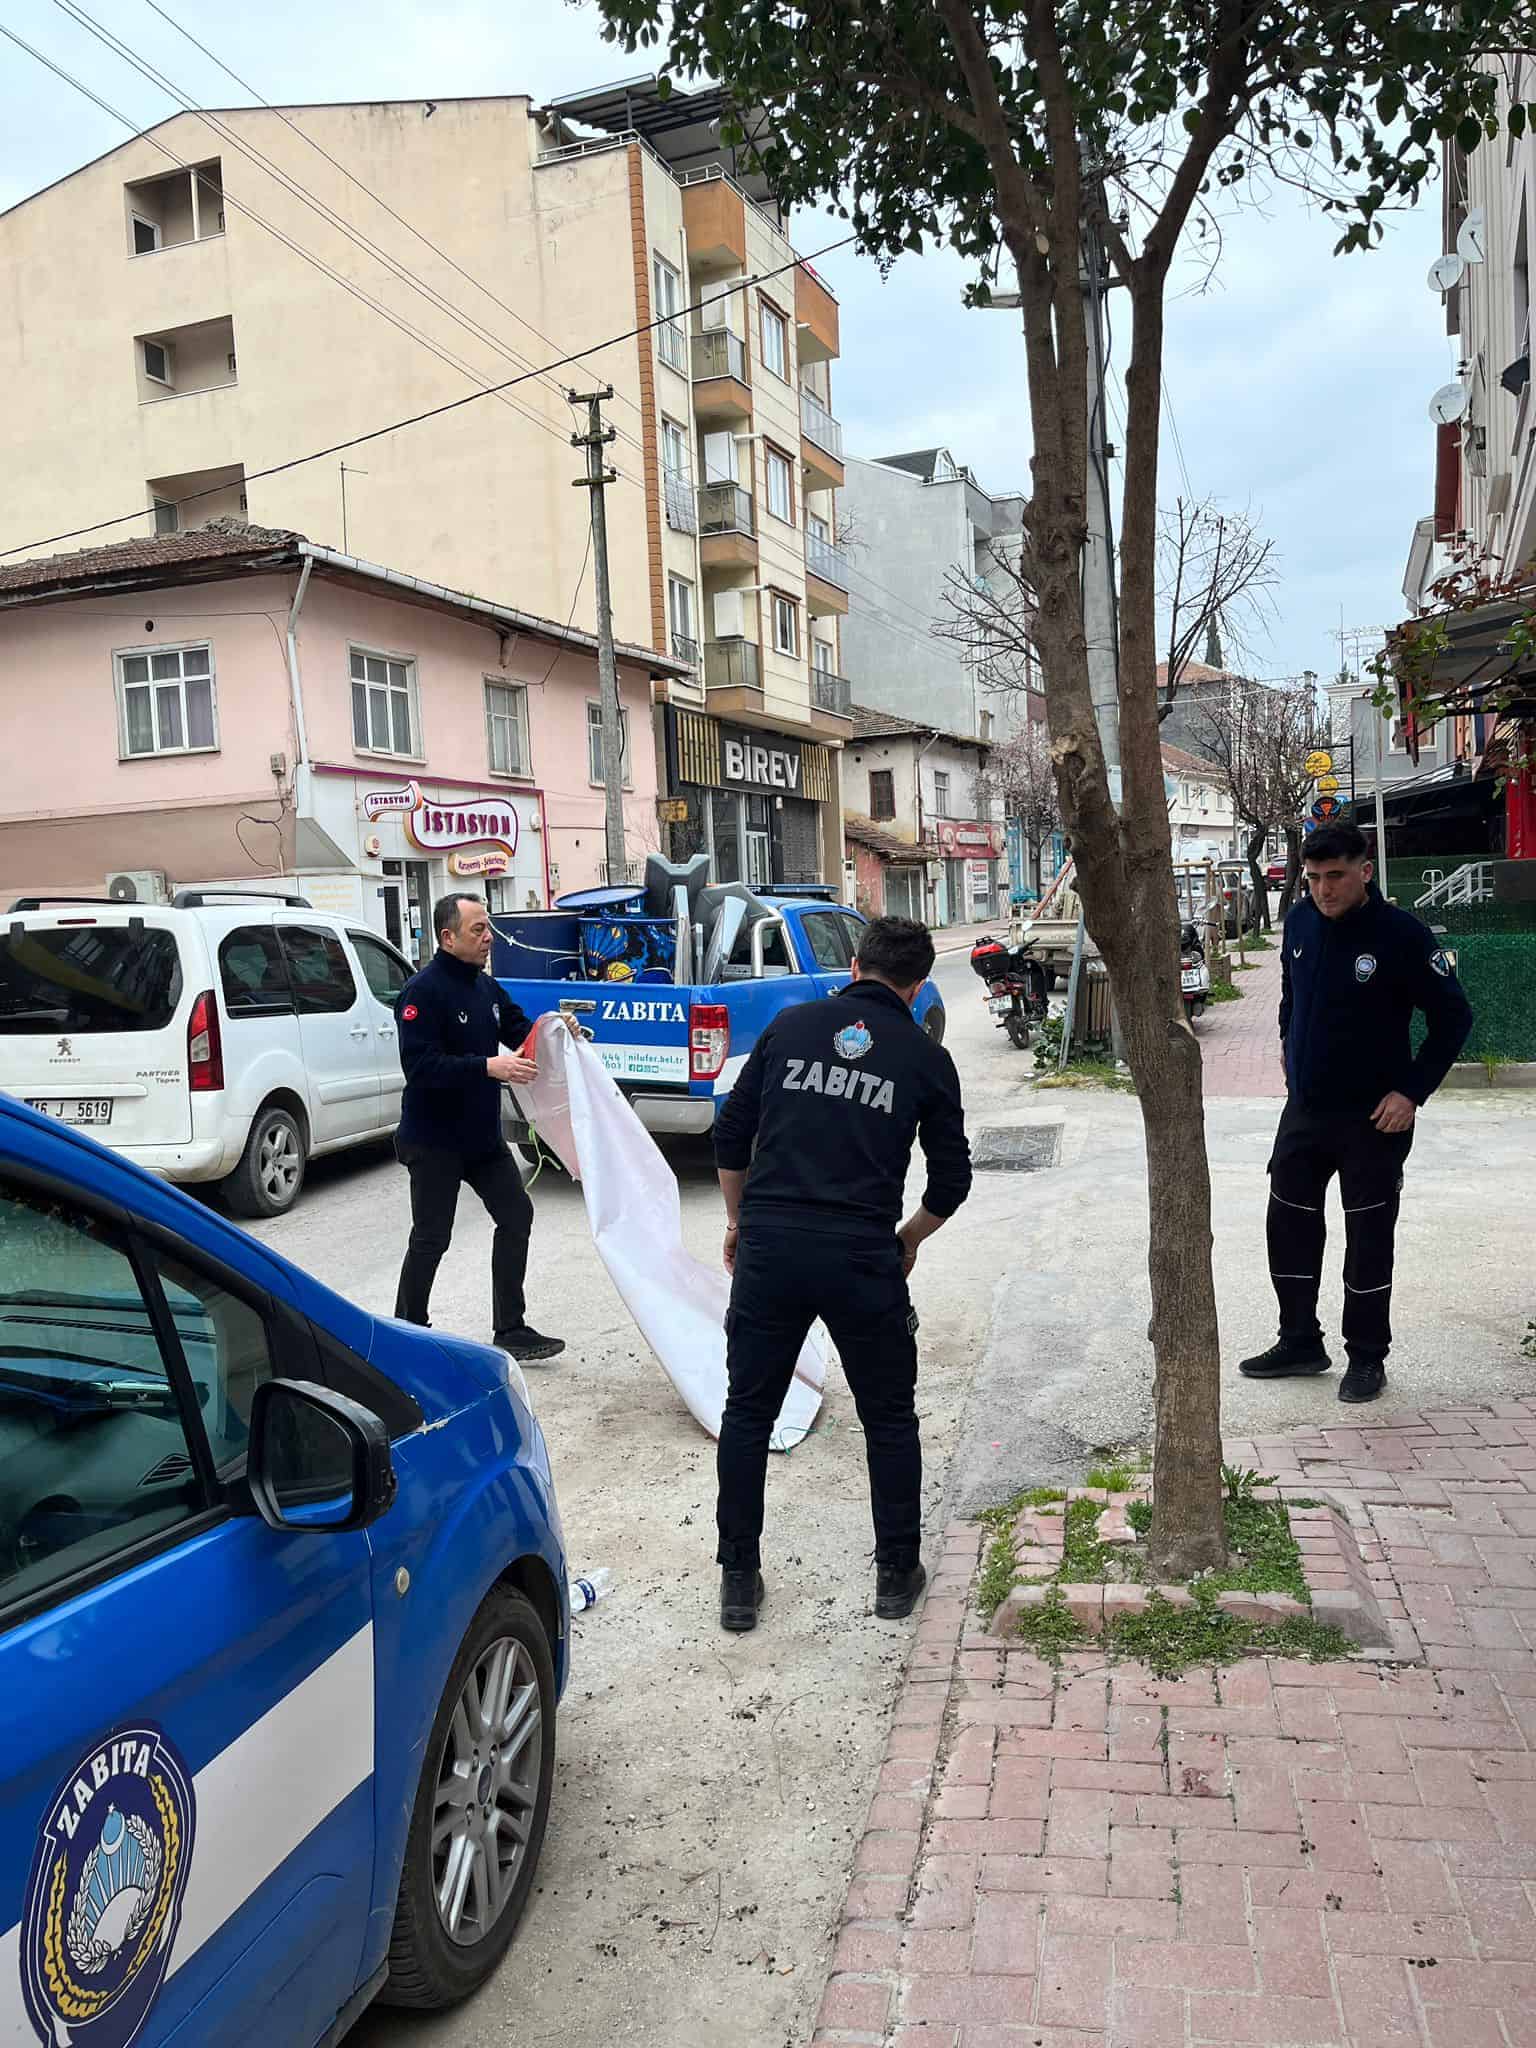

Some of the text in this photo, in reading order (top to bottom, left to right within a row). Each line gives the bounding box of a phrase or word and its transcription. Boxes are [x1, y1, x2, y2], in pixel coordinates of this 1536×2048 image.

[725, 735, 800, 789] BİREV
[423, 805, 511, 836] İSTASYON
[602, 1001, 687, 1022] ZABITA
[782, 1059, 895, 1114] ZABITA
[55, 1102, 65, 1117] J
[77, 1102, 109, 1118] 5619
[56, 1740, 151, 1840] ZABITA
